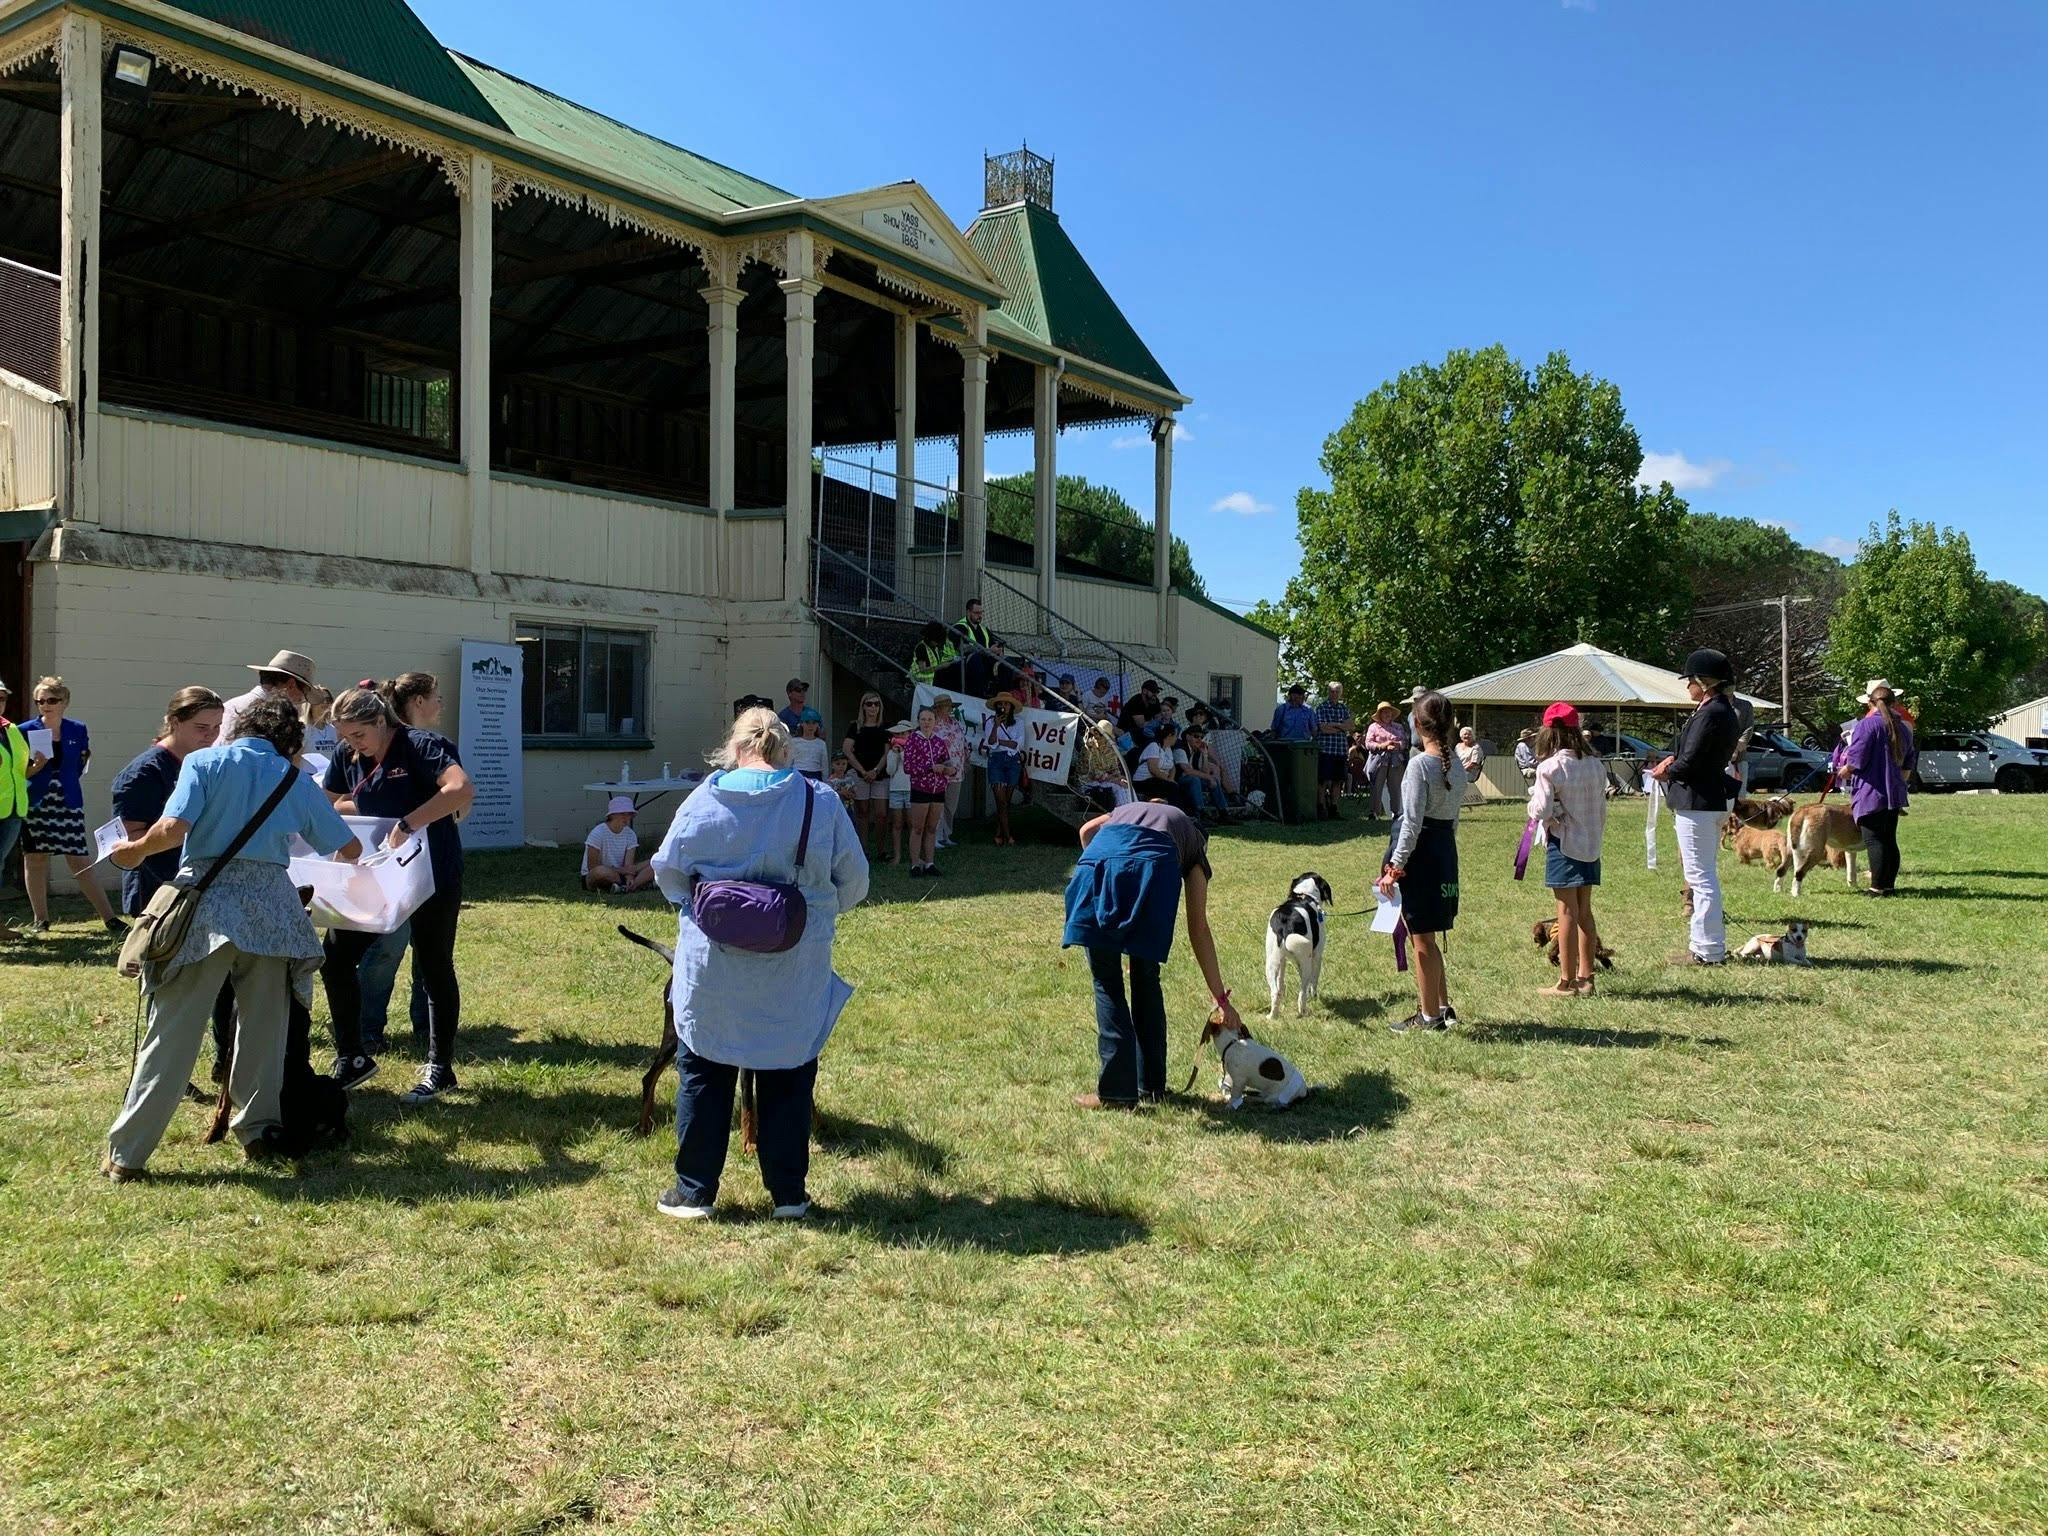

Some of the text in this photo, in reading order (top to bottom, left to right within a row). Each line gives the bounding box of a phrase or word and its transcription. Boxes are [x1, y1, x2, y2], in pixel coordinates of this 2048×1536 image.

[883, 213, 900, 230] SHOW
[900, 221, 927, 242] SOCIETY
[901, 209, 919, 228] YASS
[902, 232, 919, 250] 1863
[1032, 721, 1066, 746] Vet
